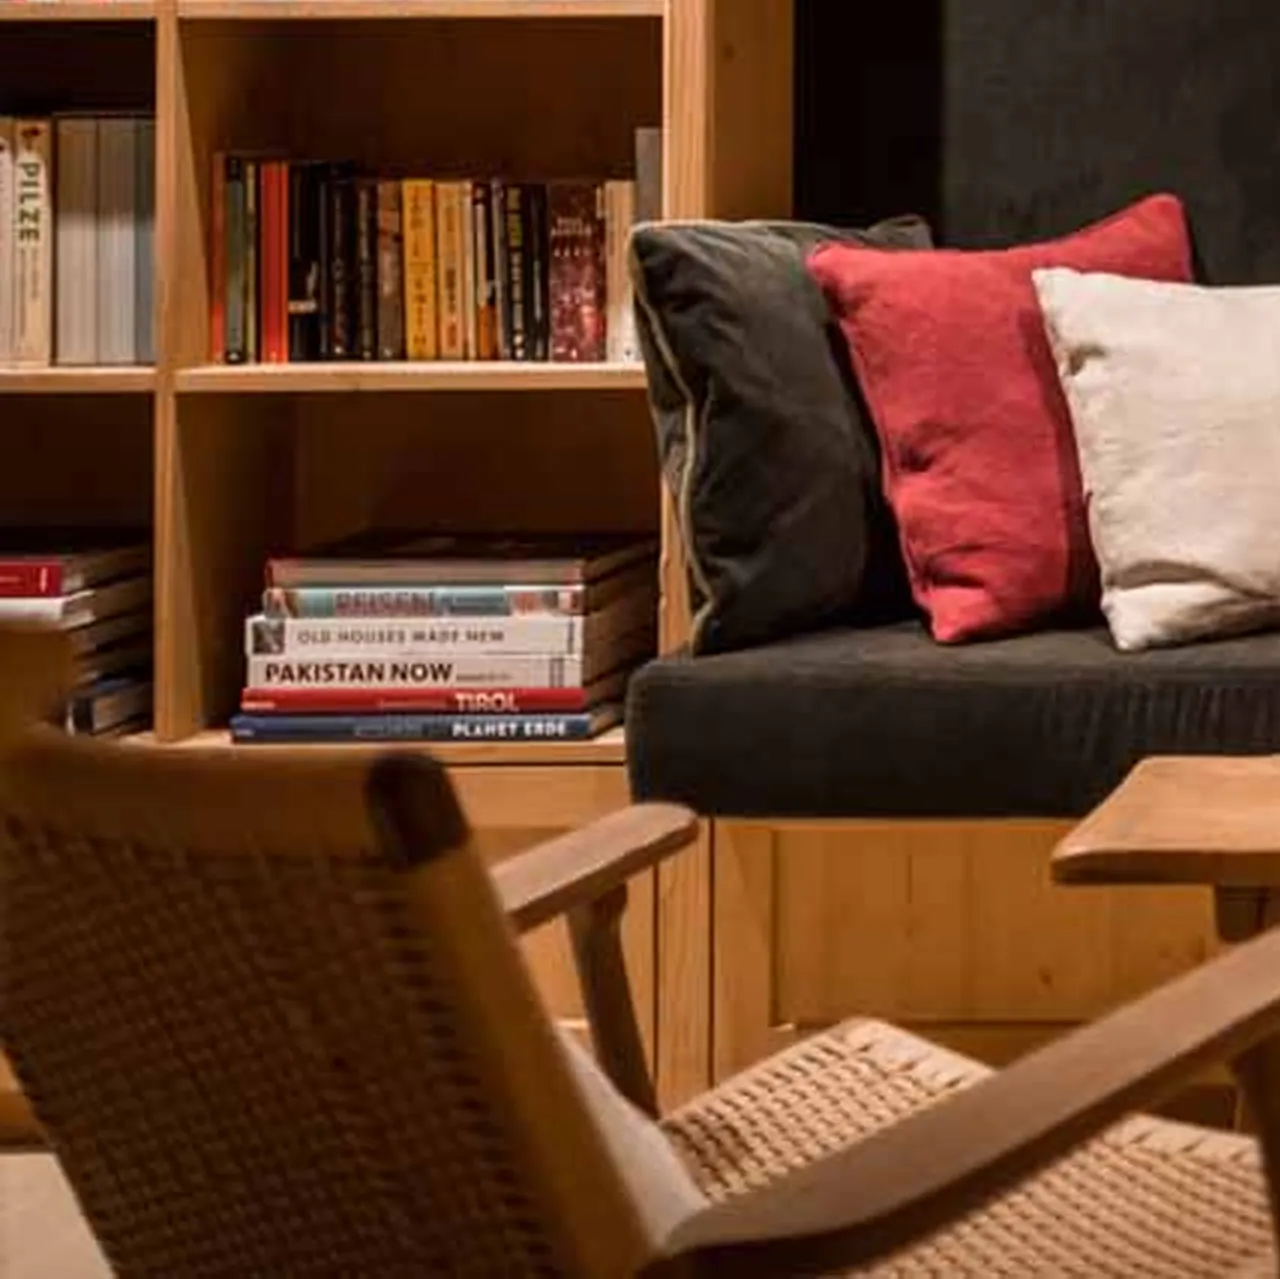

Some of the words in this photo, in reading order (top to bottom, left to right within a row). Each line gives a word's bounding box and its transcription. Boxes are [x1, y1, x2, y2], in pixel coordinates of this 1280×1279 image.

[19, 161, 41, 243] PILZE
[297, 628, 333, 644] OLD
[338, 628, 406, 644] HOUSES
[413, 627, 458, 643] MADE
[265, 663, 385, 684] PAKISTAN
[390, 663, 453, 683] NOW
[455, 692, 520, 711] TIROL
[452, 720, 517, 737] PLANET
[523, 720, 567, 736] ERDE
